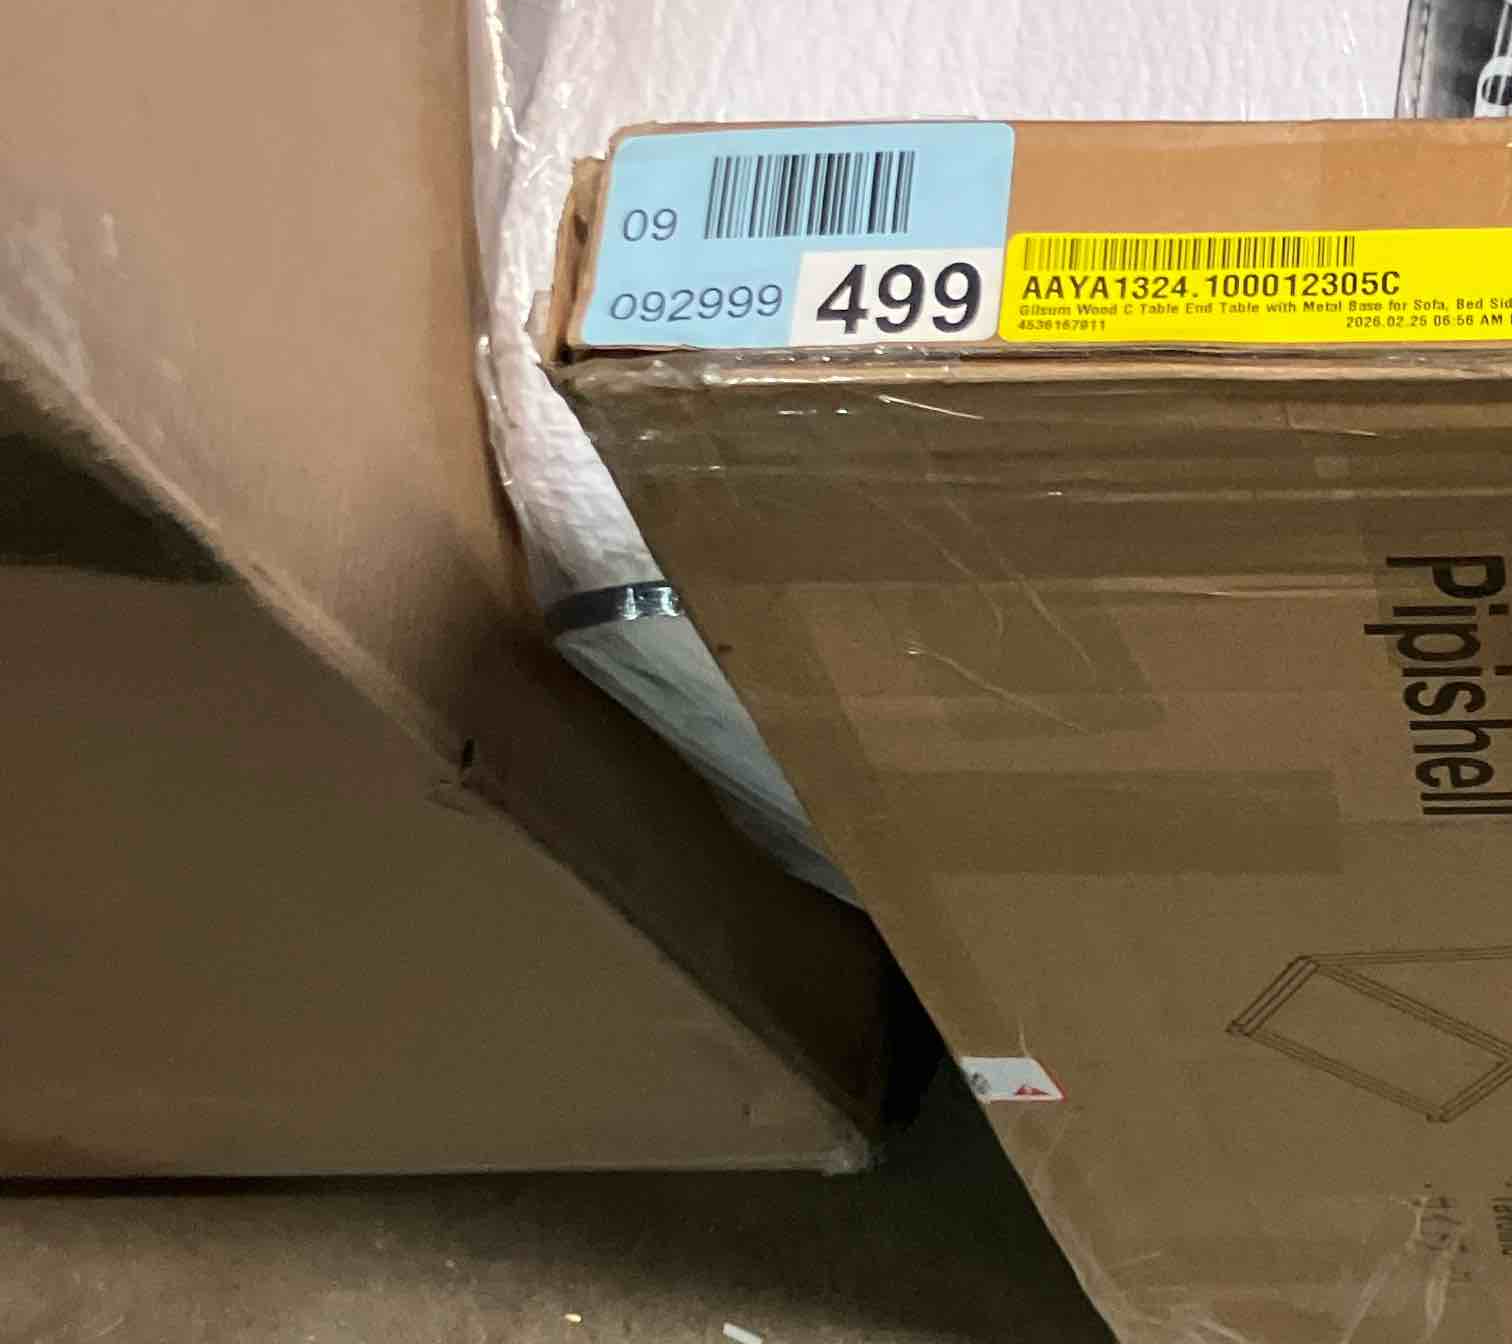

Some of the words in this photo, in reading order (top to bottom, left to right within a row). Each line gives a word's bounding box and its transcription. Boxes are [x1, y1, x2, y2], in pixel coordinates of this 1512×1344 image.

[622, 208, 678, 242] 09
[609, 284, 784, 322] 092999
[816, 262, 982, 335] 499
[1022, 270, 1401, 300] AAYA1324.100012305C
[1077, 303, 1117, 315] Wood
[1140, 302, 1179, 315] Table
[1186, 302, 1213, 314] End
[1220, 302, 1260, 314] Table
[1266, 301, 1297, 313] with
[1303, 301, 1342, 313] Metal
[1349, 300, 1382, 312] Base
[1388, 299, 1408, 311] for
[1456, 298, 1483, 310] Bed
[1479, 313, 1503, 326] AM
